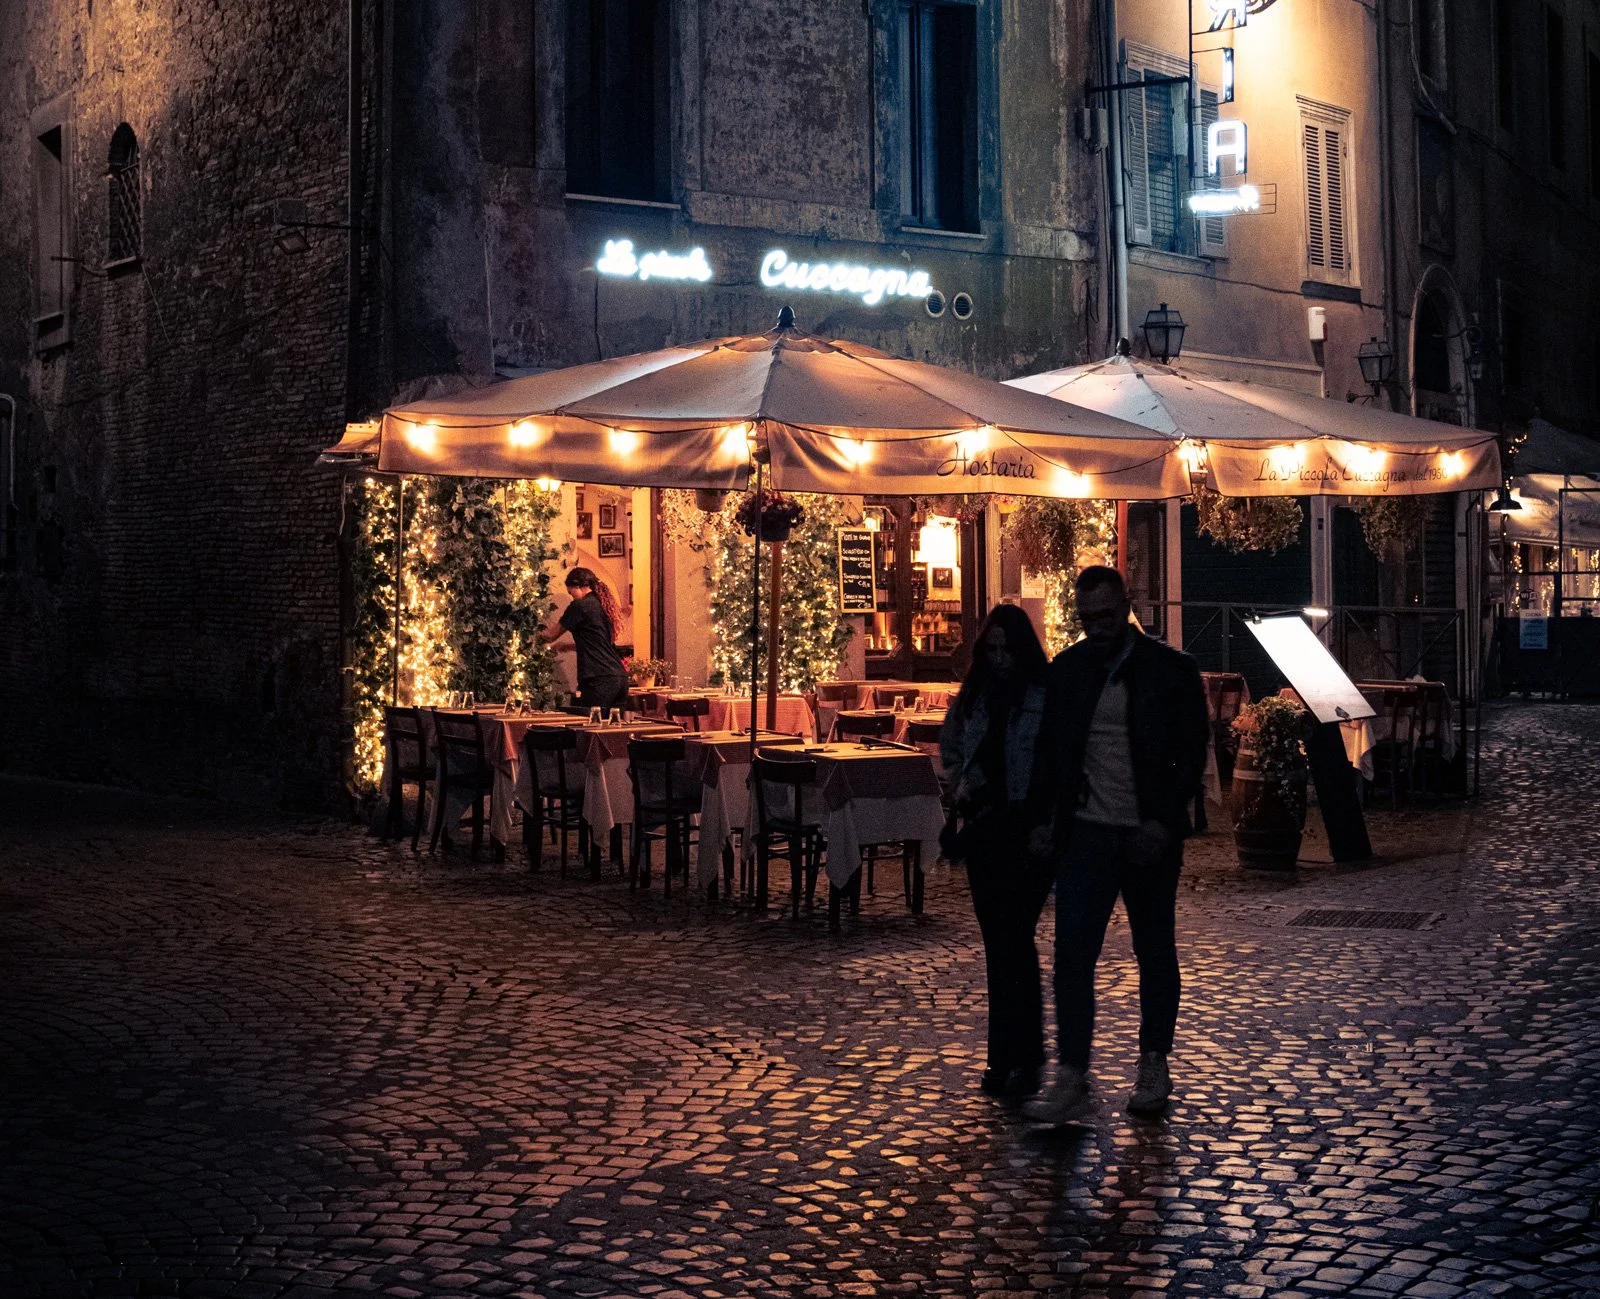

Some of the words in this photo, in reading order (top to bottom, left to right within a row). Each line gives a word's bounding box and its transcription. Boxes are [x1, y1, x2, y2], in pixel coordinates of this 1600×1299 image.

[761, 250, 933, 304] Cuccagna
[936, 441, 1036, 479] Hostaria
[1253, 457, 1277, 481] La
[1281, 455, 1338, 481] Piccola
